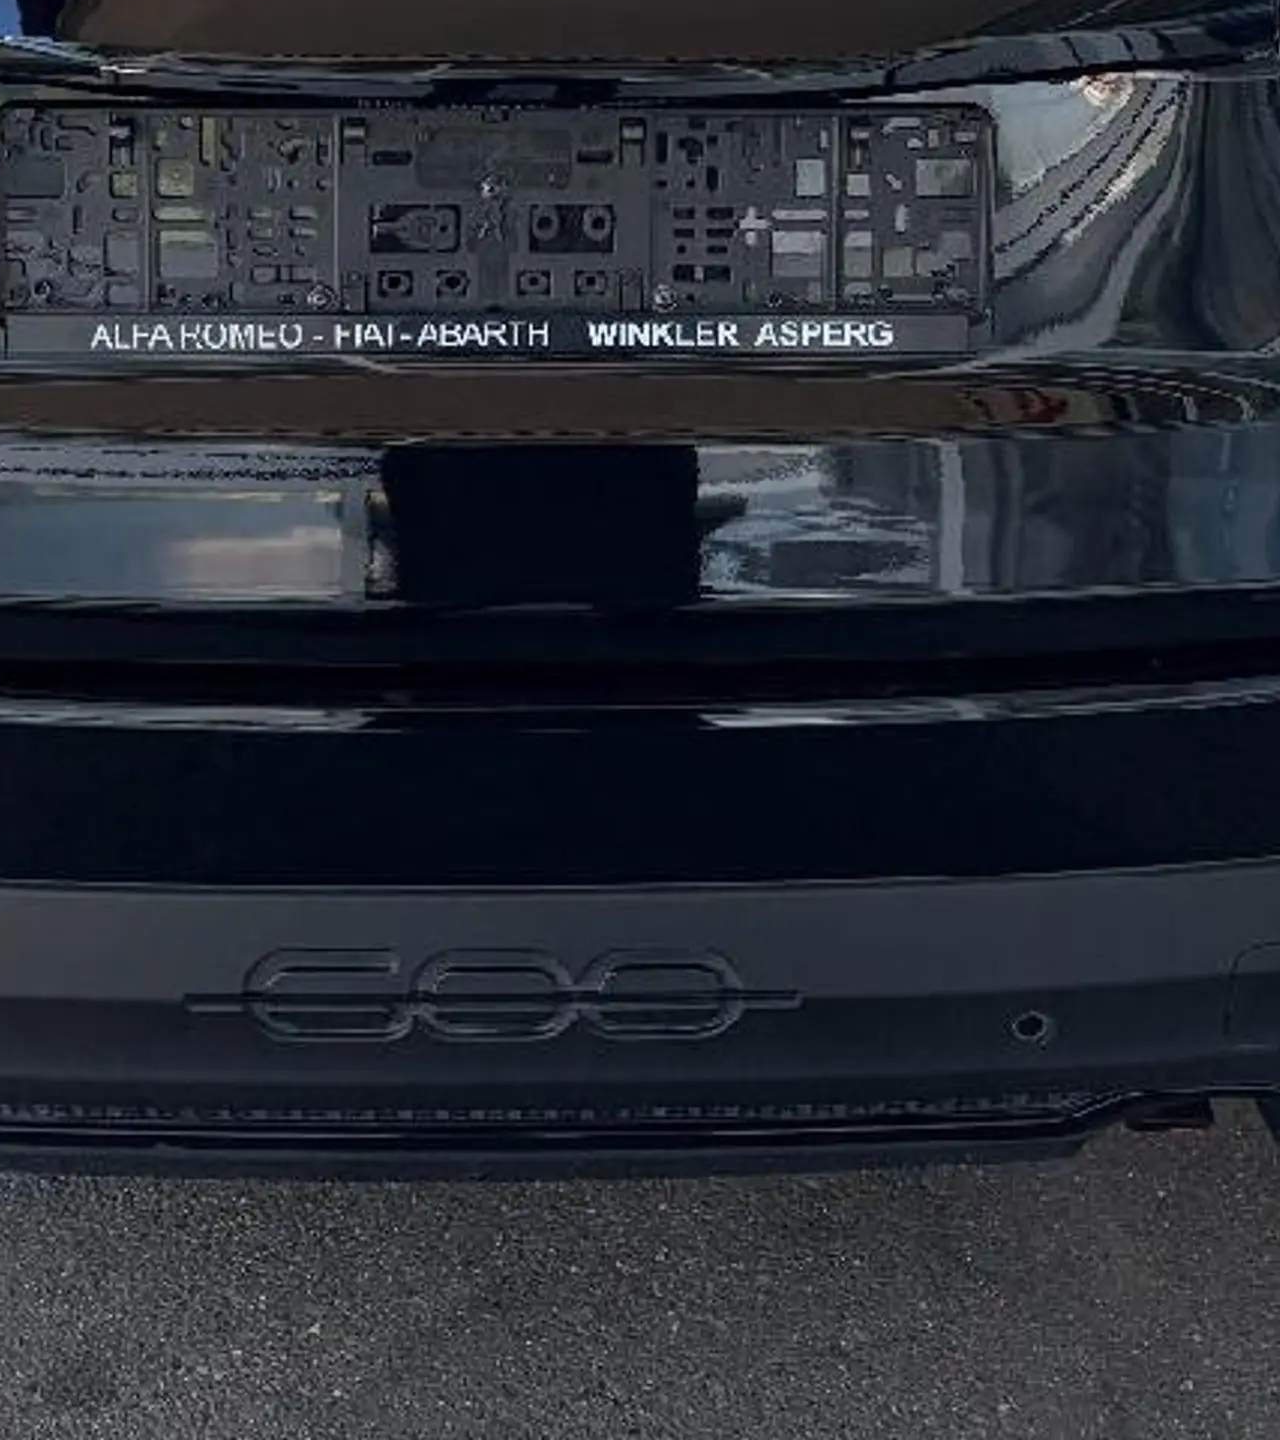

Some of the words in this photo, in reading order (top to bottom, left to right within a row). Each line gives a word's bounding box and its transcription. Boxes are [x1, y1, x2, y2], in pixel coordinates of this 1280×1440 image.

[91, 323, 173, 350] ALFA
[180, 323, 304, 350] ROMEO
[417, 321, 549, 348] ABARTH
[588, 320, 741, 347] WINKLER
[754, 320, 895, 347] ASPERG
